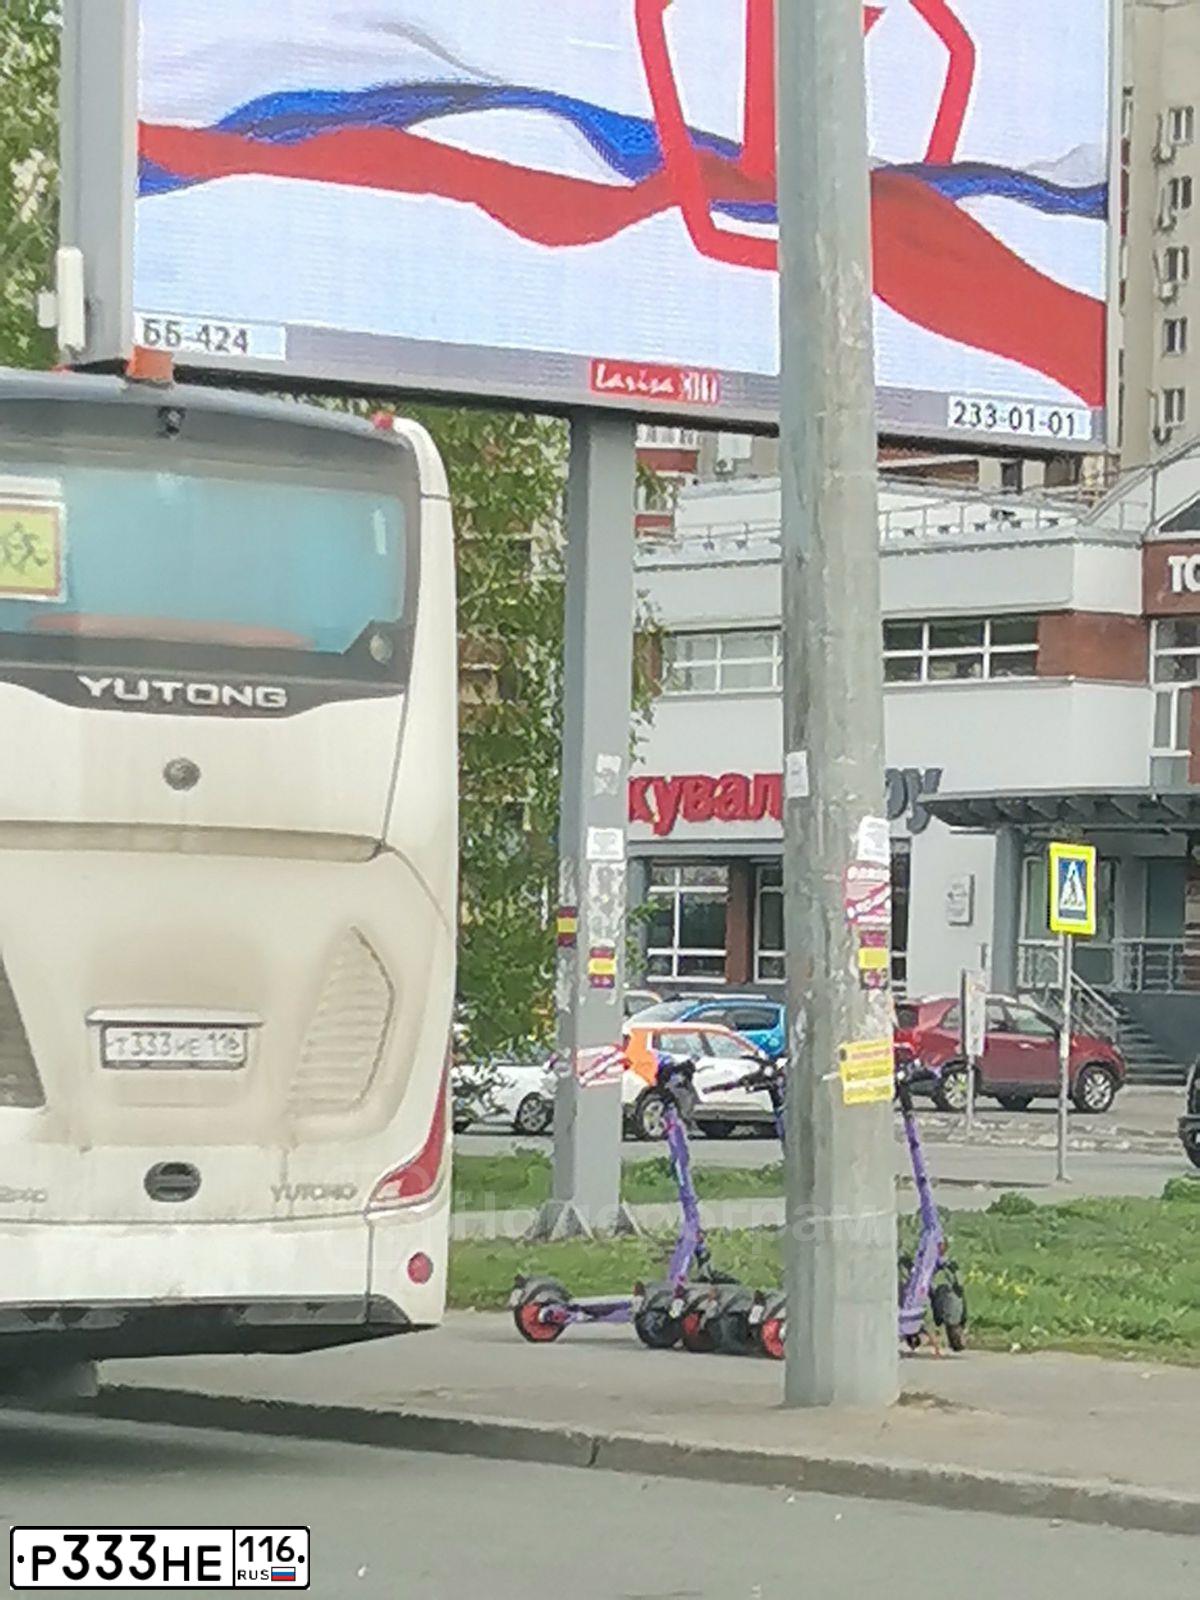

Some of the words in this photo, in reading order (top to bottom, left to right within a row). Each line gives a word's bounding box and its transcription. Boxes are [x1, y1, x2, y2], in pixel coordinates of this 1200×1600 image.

[953, 400, 1075, 438] 233-01-01
[77, 675, 288, 709] YUTONG
[628, 772, 783, 837] кувал
